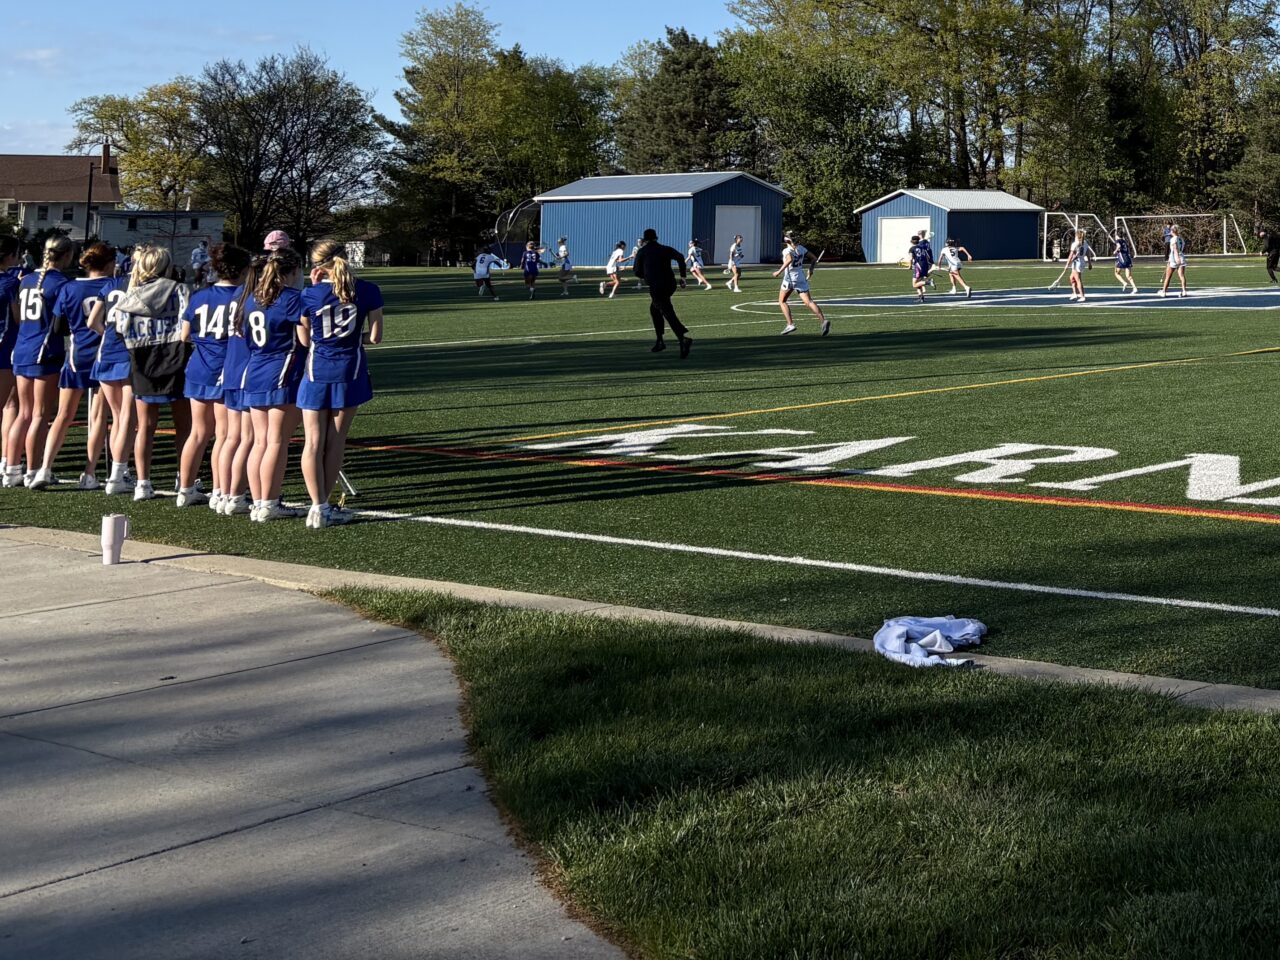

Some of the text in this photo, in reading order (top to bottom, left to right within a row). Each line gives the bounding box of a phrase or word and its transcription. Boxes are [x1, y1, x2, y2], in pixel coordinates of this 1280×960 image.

[950, 248, 956, 257] 5
[19, 288, 44, 321] 15
[195, 304, 226, 339] 14
[315, 303, 358, 338] 19
[249, 311, 267, 347] 8
